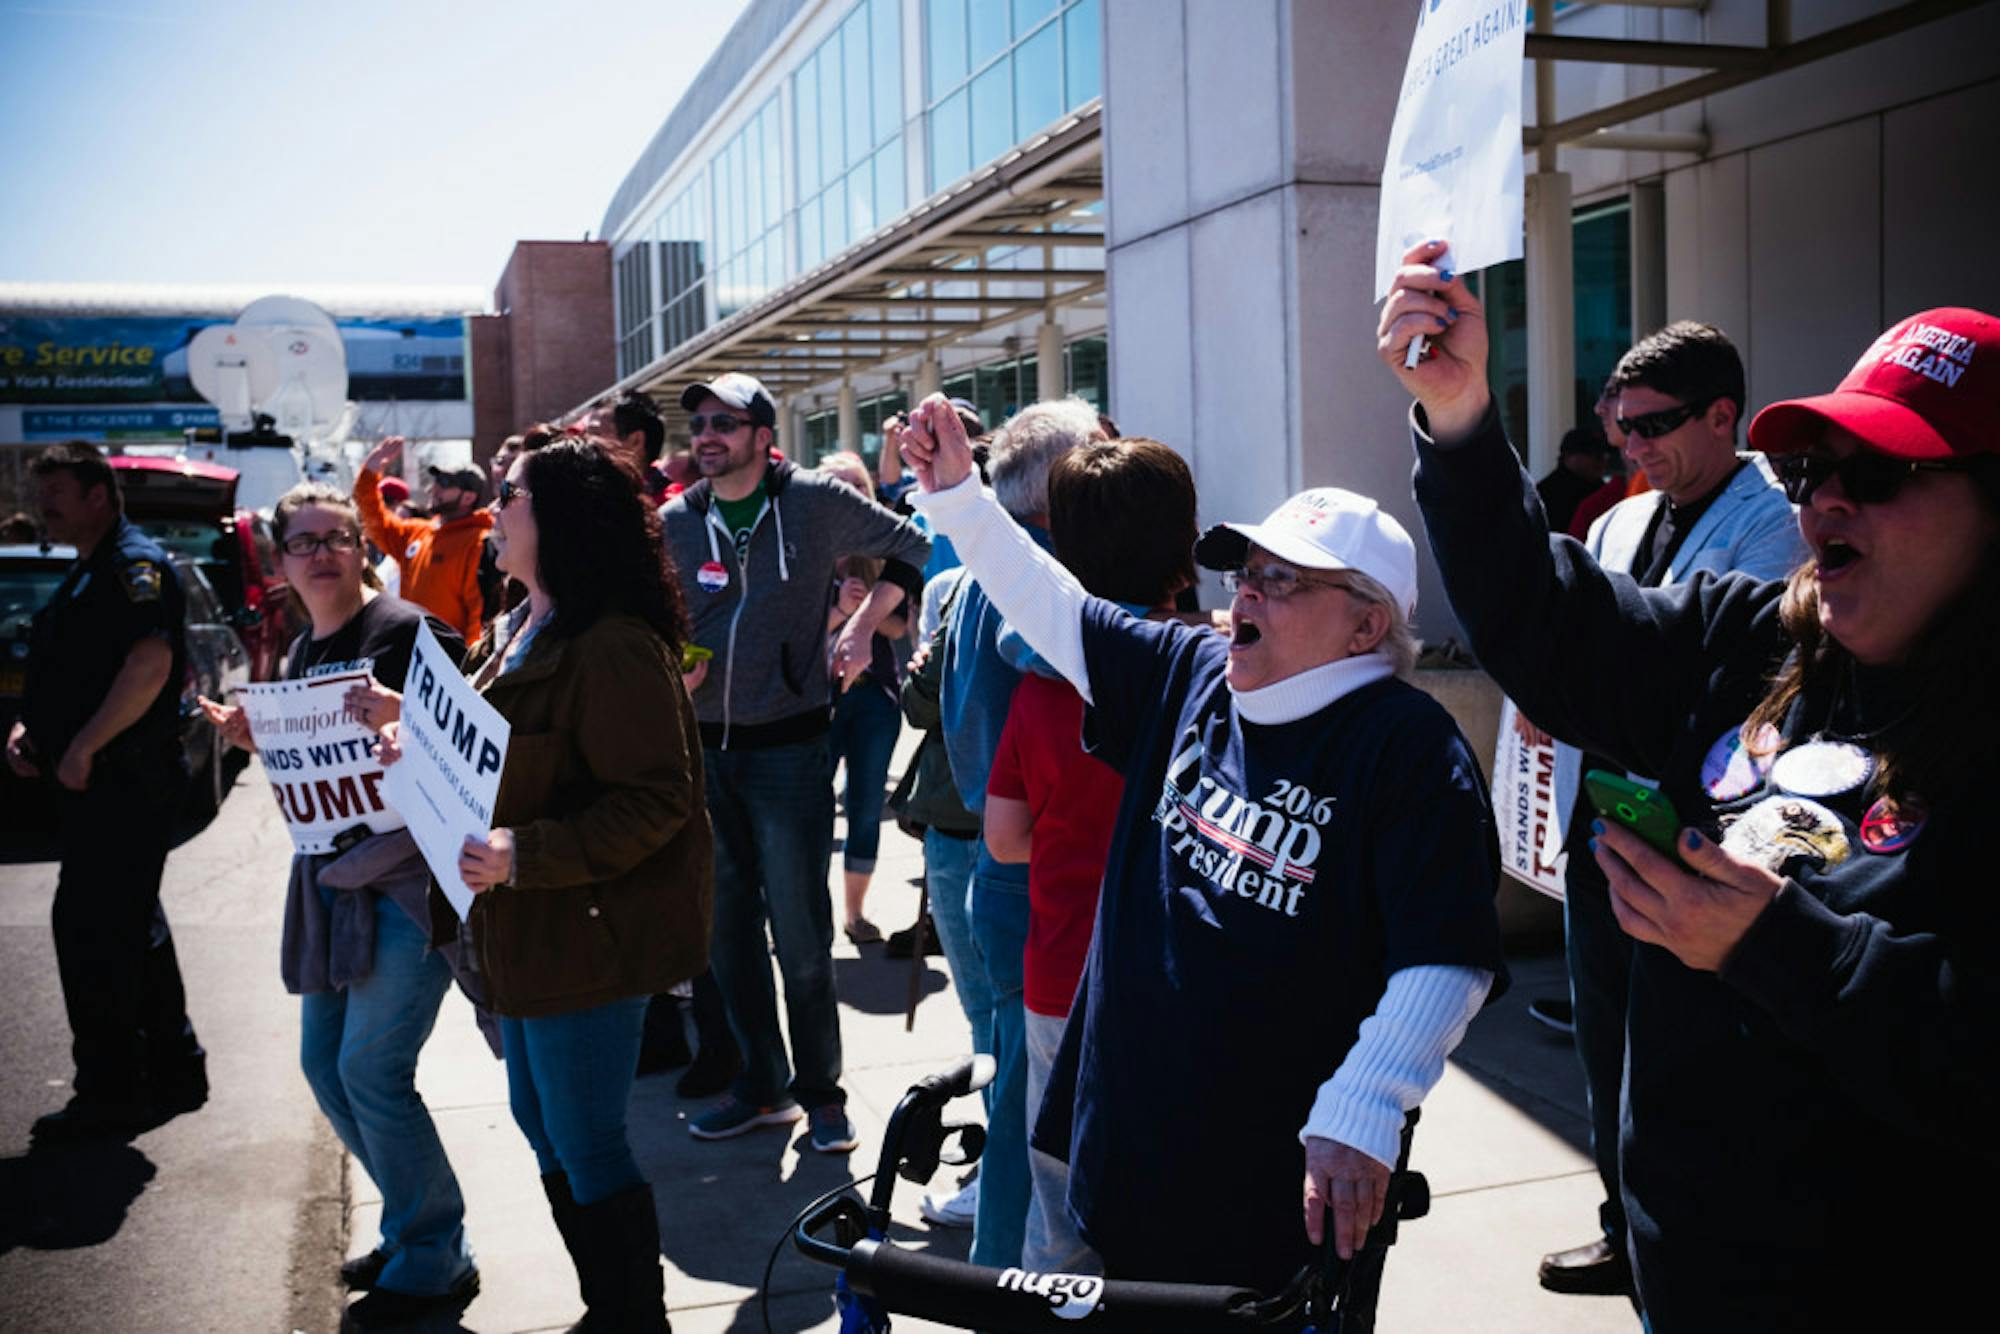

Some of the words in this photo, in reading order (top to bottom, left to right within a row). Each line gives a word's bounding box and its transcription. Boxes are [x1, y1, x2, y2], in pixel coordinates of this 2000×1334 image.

[35, 340, 155, 367] Service
[1885, 345, 1965, 387] AGAIN
[1898, 322, 1977, 363] AMERICA
[405, 647, 500, 776] TRUMP
[1163, 741, 1322, 880] Trump
[1516, 781, 1530, 870] STANDS
[1163, 803, 1305, 917] President
[997, 1267, 1099, 1308] nugo
